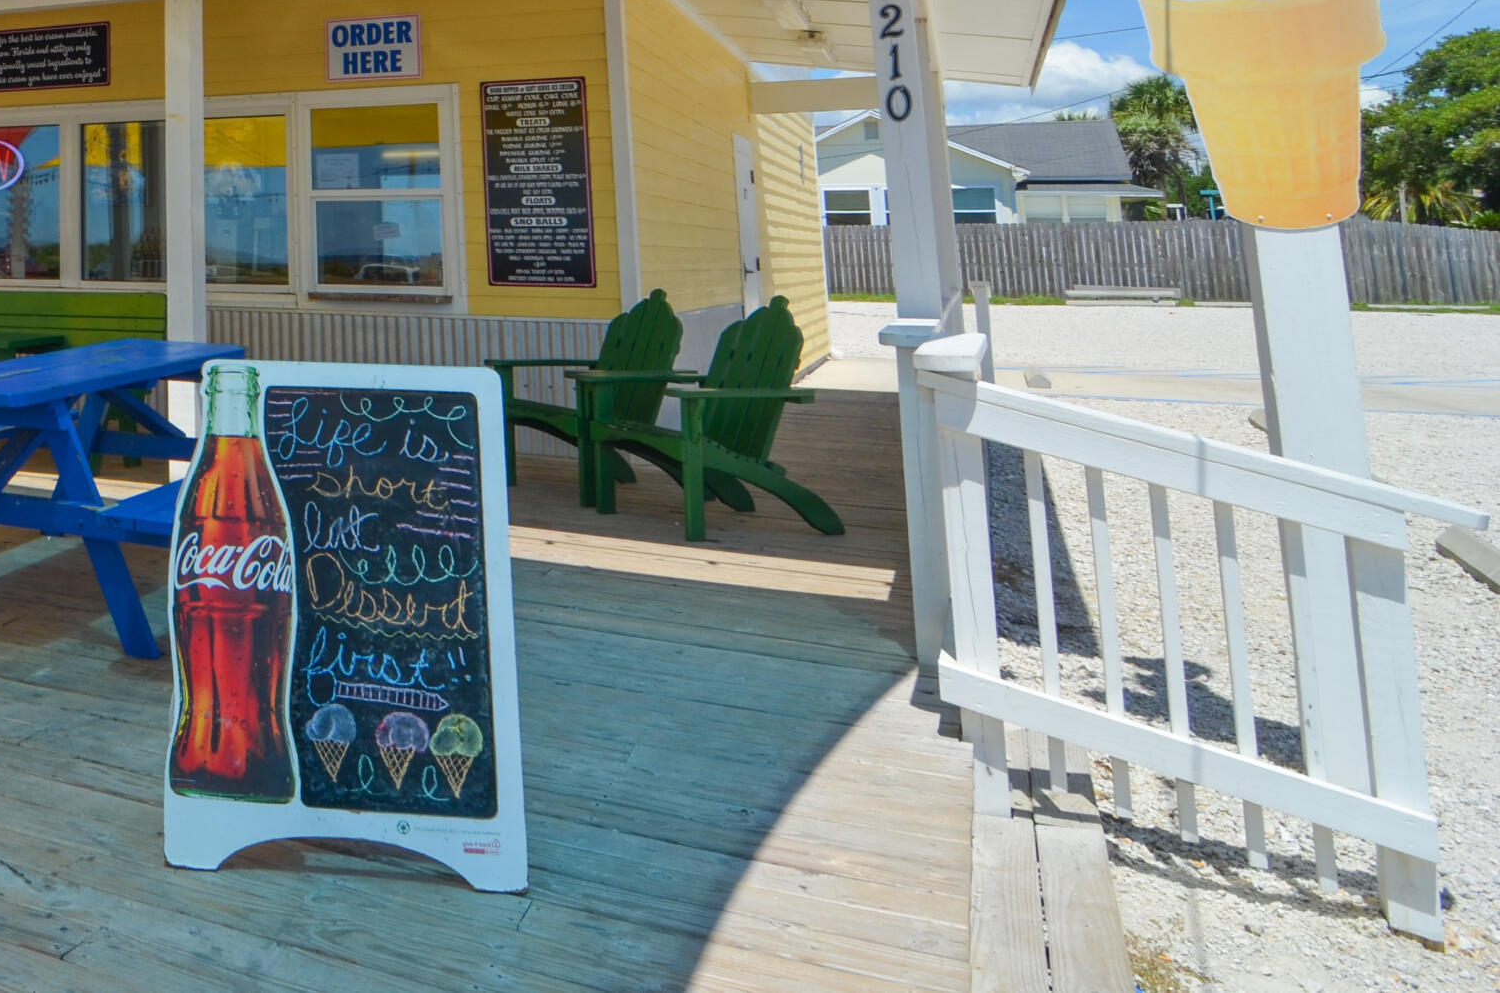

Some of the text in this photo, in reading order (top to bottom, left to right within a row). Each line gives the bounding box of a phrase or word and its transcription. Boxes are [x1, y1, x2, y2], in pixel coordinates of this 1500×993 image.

[331, 20, 413, 48] ORDER
[342, 49, 403, 75] HERE
[520, 118, 547, 126] TREATS
[525, 197, 553, 205] FLOATS
[278, 396, 449, 468] Life is
[307, 465, 449, 510] short
[174, 532, 293, 593] Coca-Cola
[306, 553, 479, 638] Dessert
